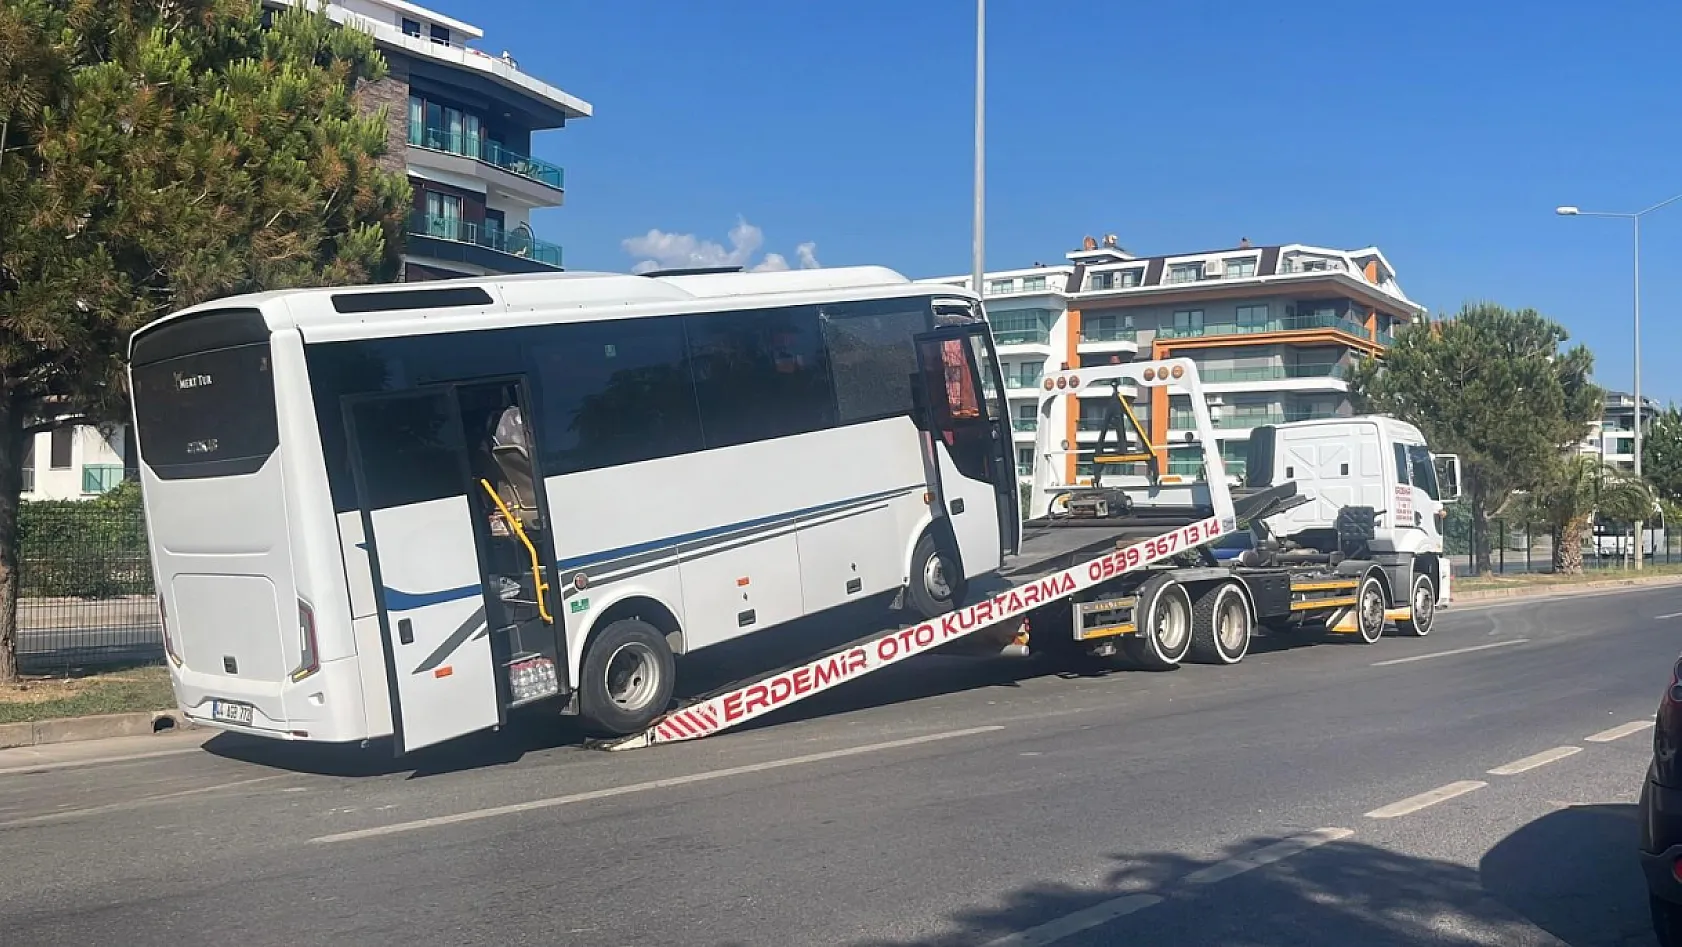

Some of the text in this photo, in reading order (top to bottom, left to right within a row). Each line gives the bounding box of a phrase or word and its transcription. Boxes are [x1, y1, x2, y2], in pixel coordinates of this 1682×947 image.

[877, 624, 935, 661] OTO
[941, 572, 1077, 638] KURTARMA
[1089, 546, 1139, 581] 0539
[1145, 533, 1178, 560] 367
[1184, 525, 1200, 545] 13
[1205, 518, 1221, 538] 14
